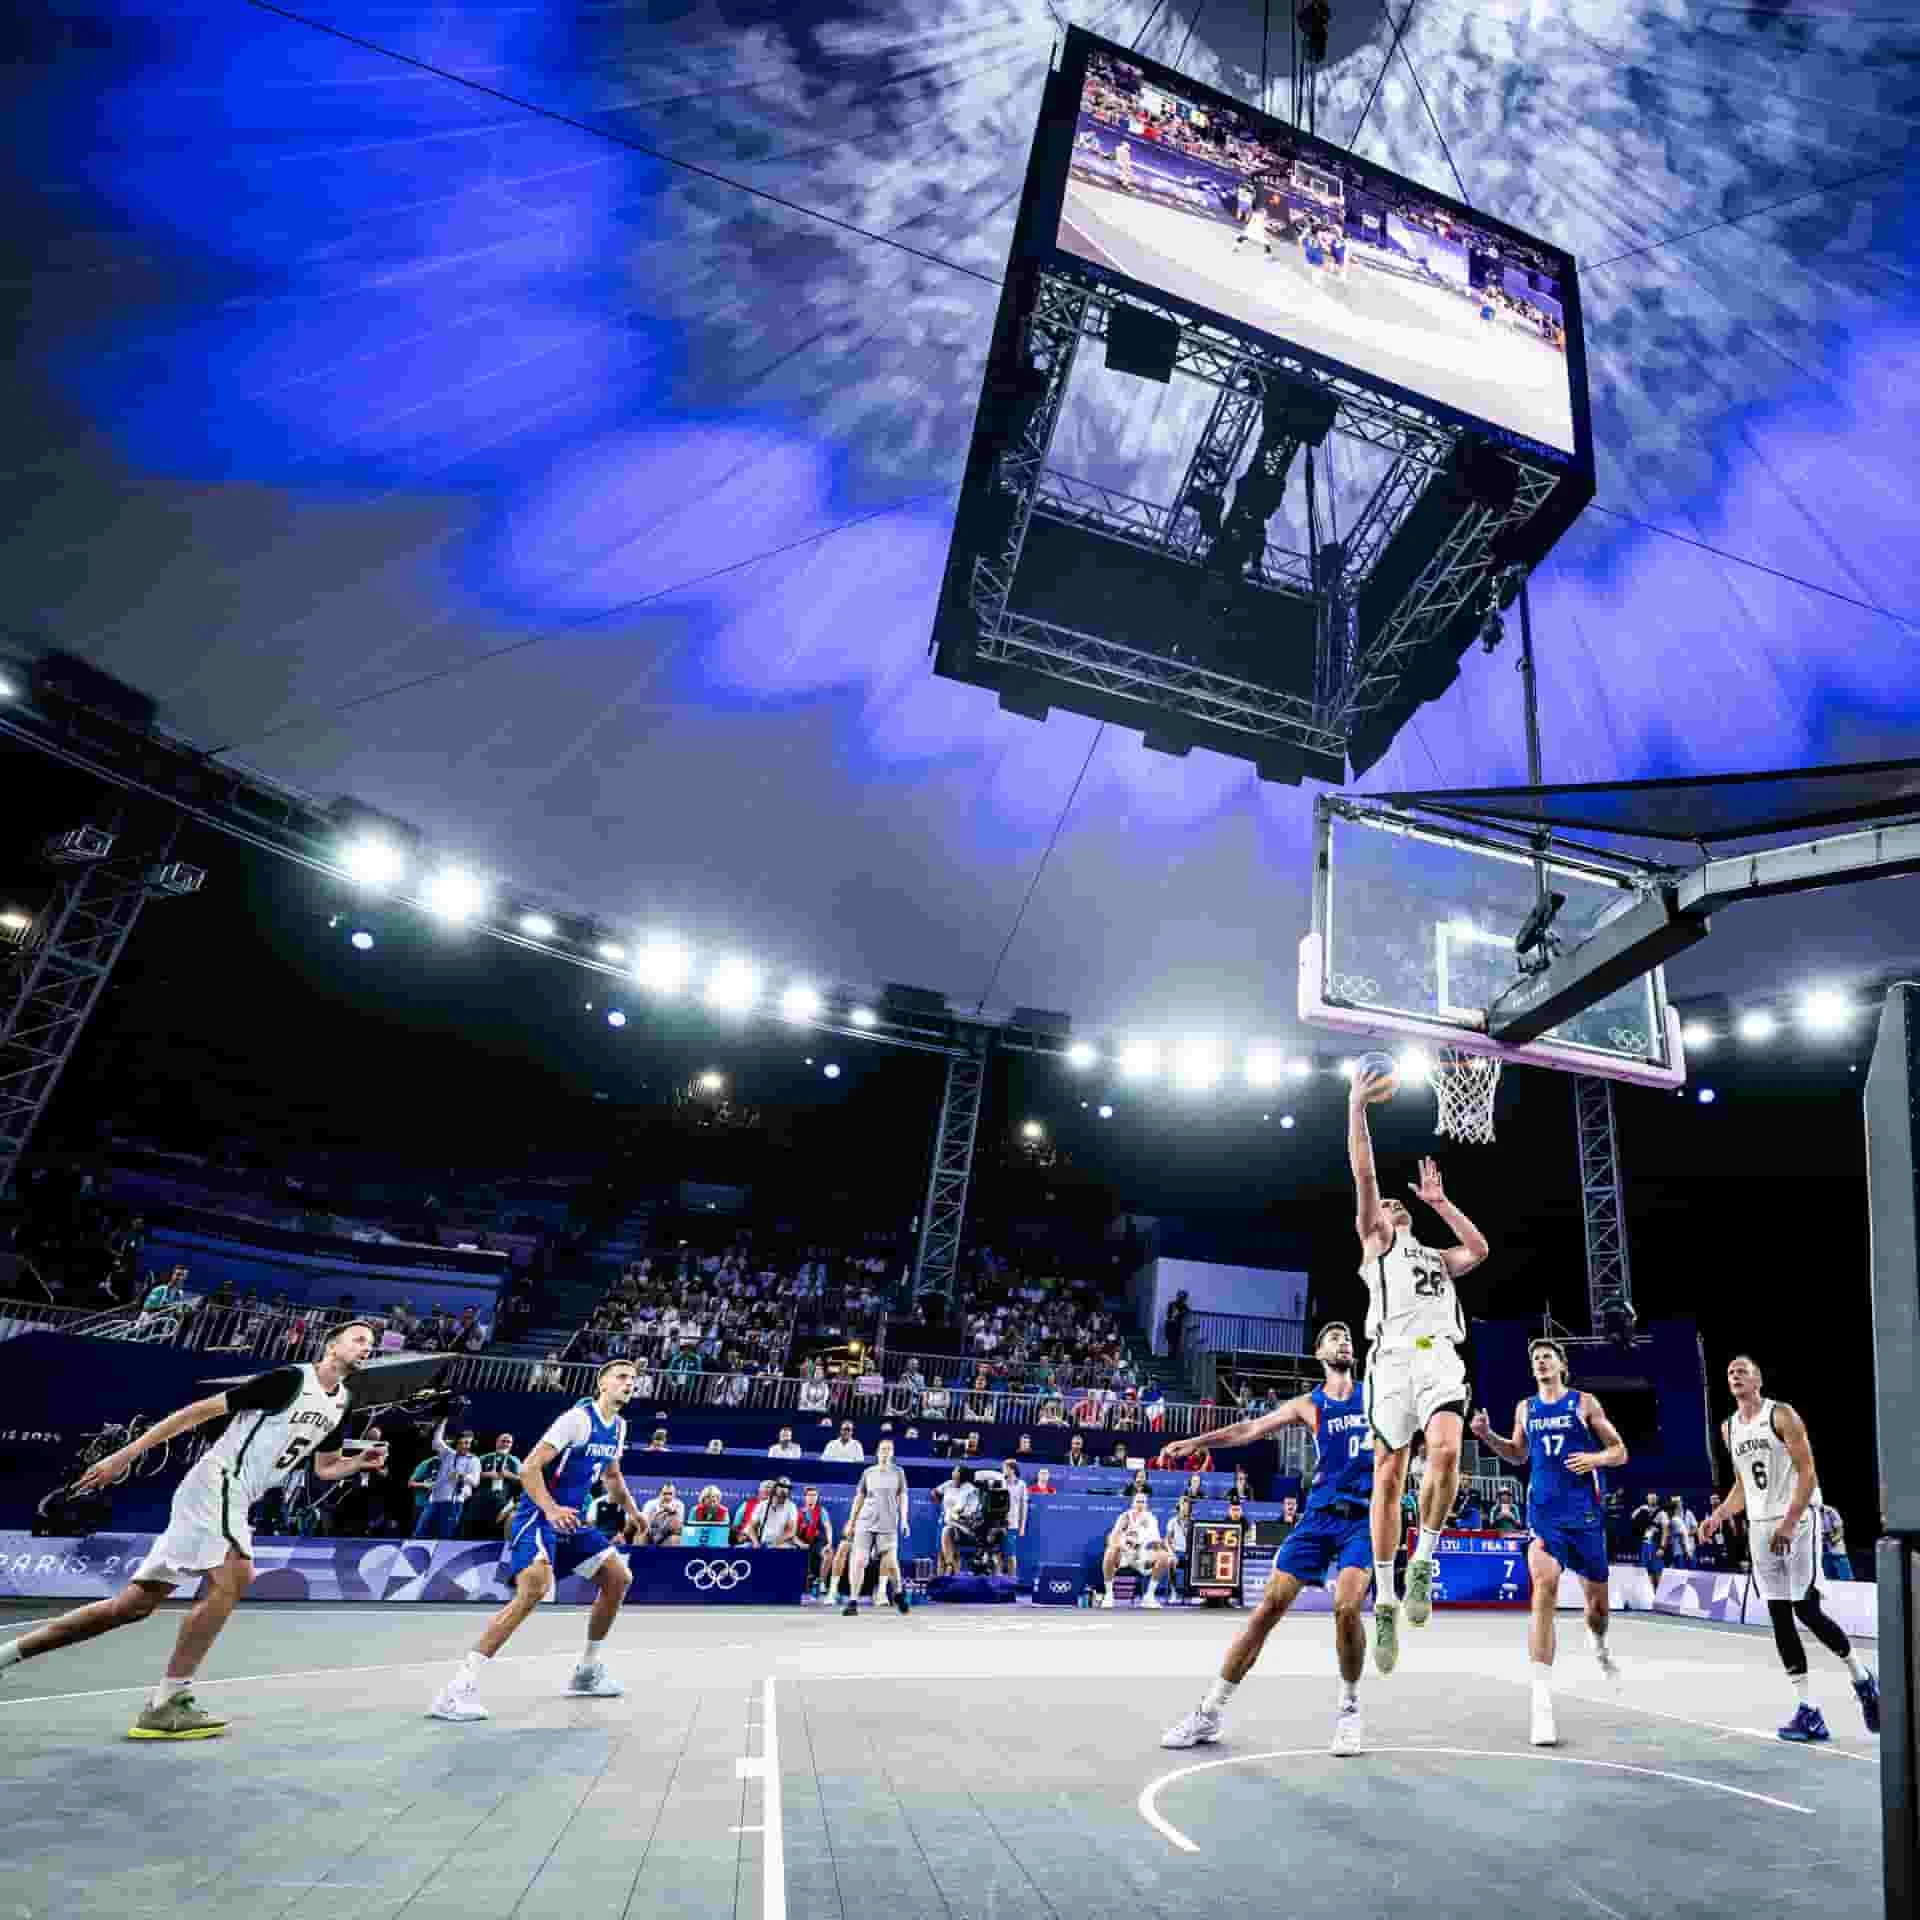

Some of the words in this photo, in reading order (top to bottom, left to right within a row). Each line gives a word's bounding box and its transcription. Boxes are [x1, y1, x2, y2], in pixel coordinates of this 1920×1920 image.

[1327, 1415, 1370, 1433] FRANC
[1529, 1415, 1574, 1433] FRANCE
[275, 1437, 311, 1469] 5
[1541, 1433, 1565, 1456] 17
[1751, 1460, 1769, 1491] 6
[1503, 1559, 1516, 1578] 7
